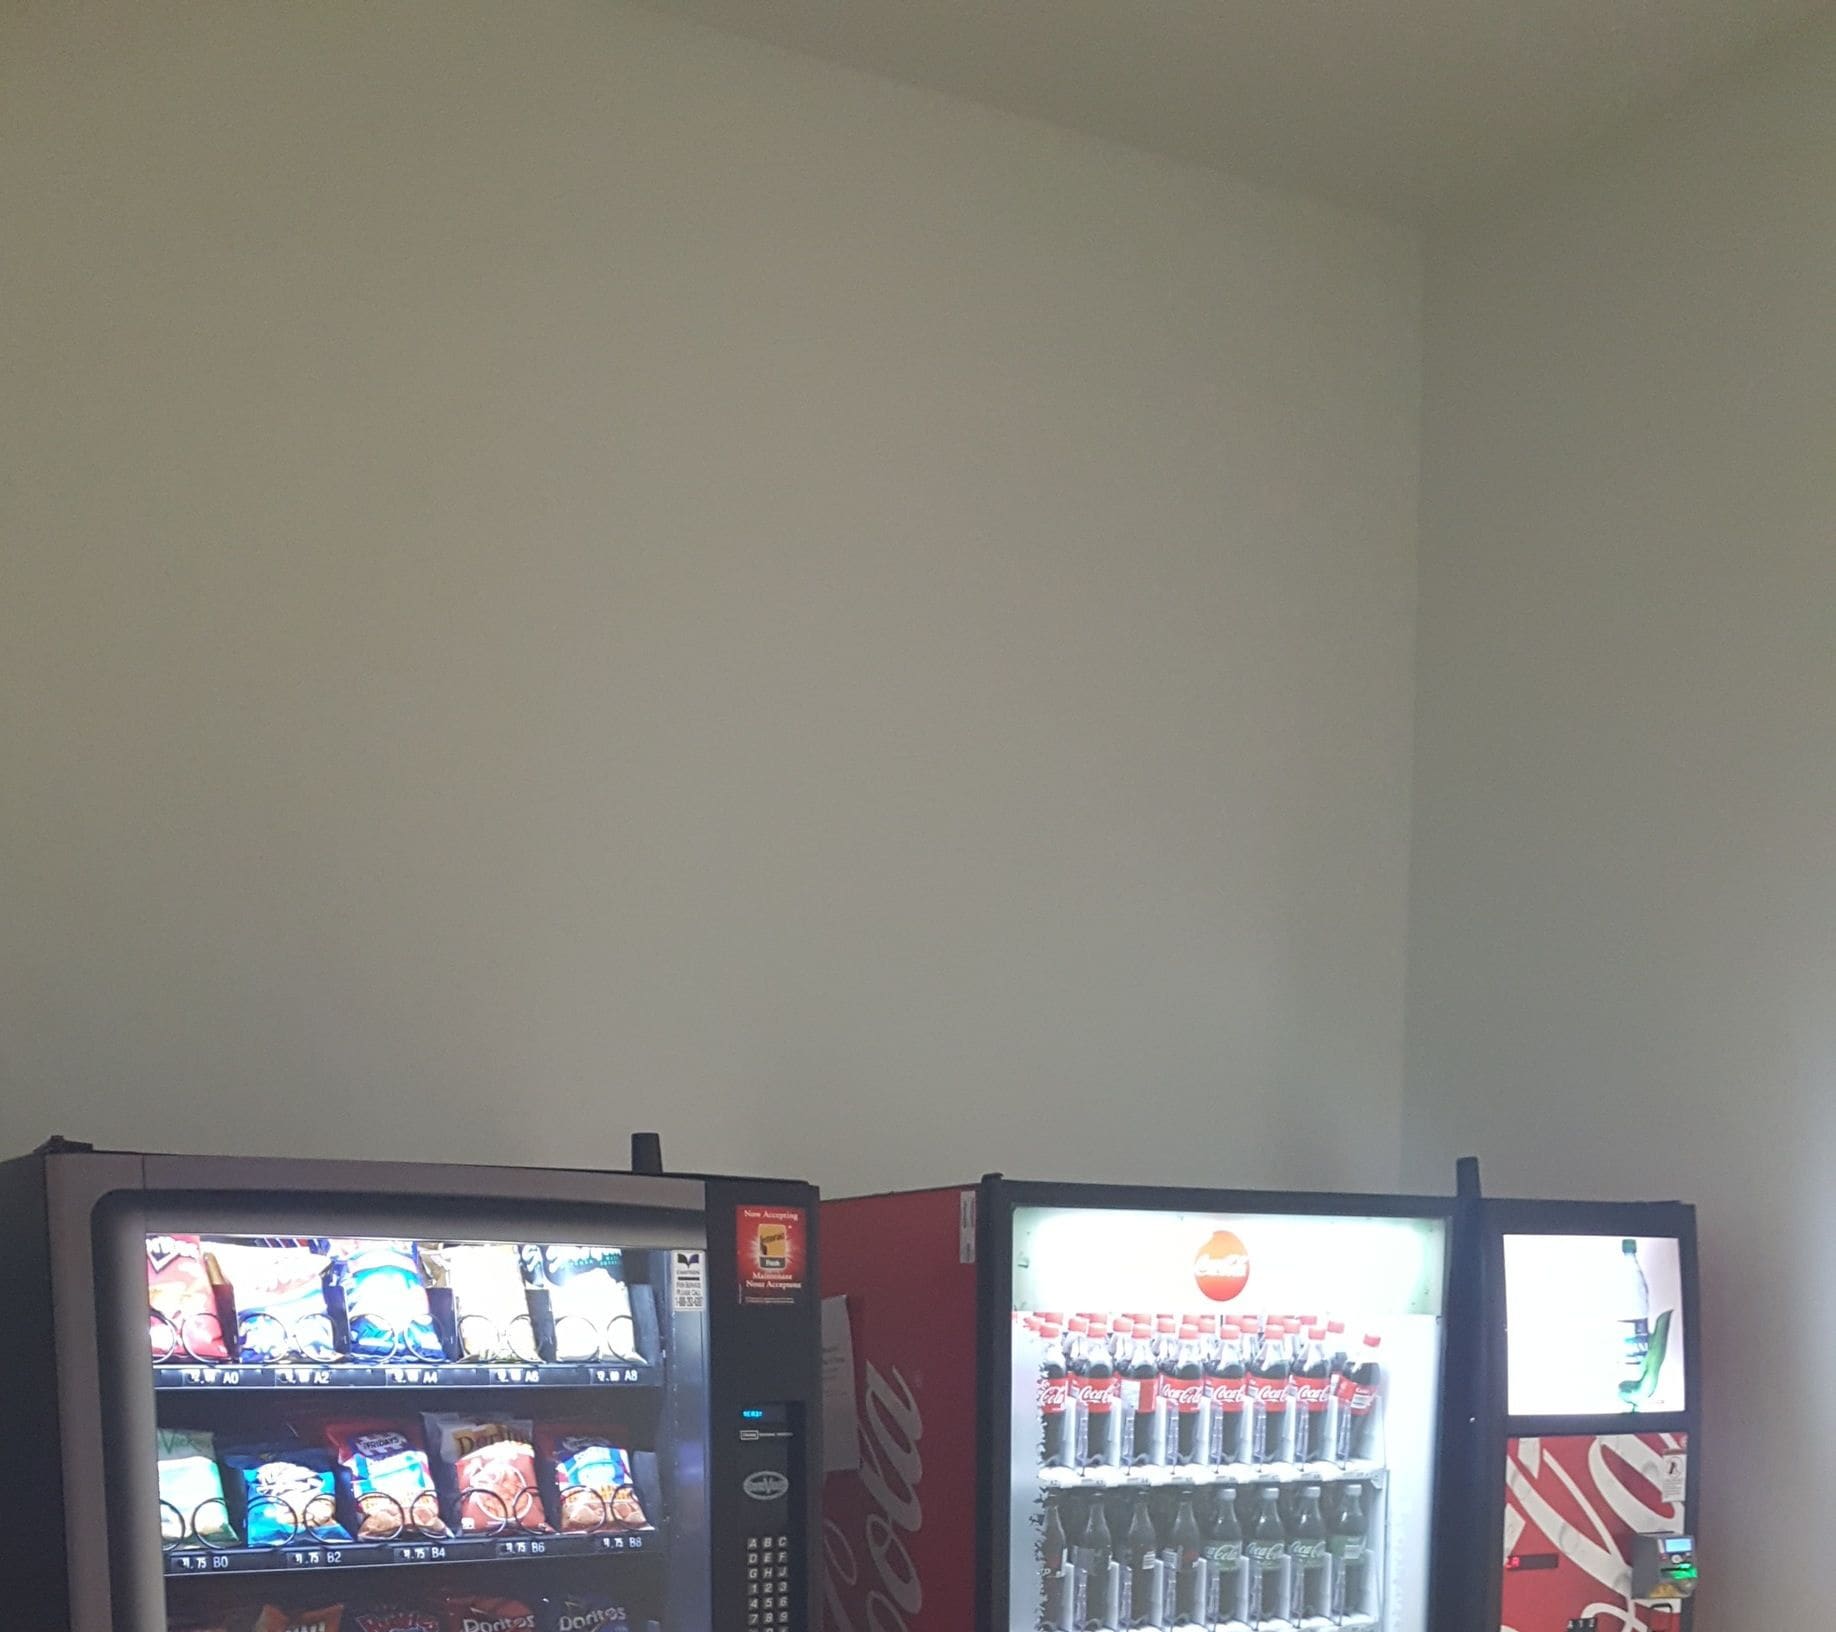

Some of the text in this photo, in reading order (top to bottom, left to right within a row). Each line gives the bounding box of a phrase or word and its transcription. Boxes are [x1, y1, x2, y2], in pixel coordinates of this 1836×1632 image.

[744, 1209, 799, 1221] Now Accepting
[223, 1371, 239, 1384] A0
[314, 1371, 330, 1384] A2
[423, 1371, 438, 1384] A4
[531, 1541, 546, 1553] B6
[749, 1538, 758, 1548] A
[778, 1536, 788, 1547] C
[327, 1551, 342, 1564] B2
[431, 1547, 446, 1558] B4
[749, 1551, 788, 1563] D E F
[213, 1556, 229, 1569] B0
[749, 1566, 787, 1579] G H J
[763, 1583, 773, 1593] 2
[778, 1582, 788, 1592] 3
[749, 1596, 788, 1609] 4 5 6
[559, 1606, 627, 1632] Doritos
[749, 1613, 759, 1624] 7
[779, 1611, 788, 1622] 9
